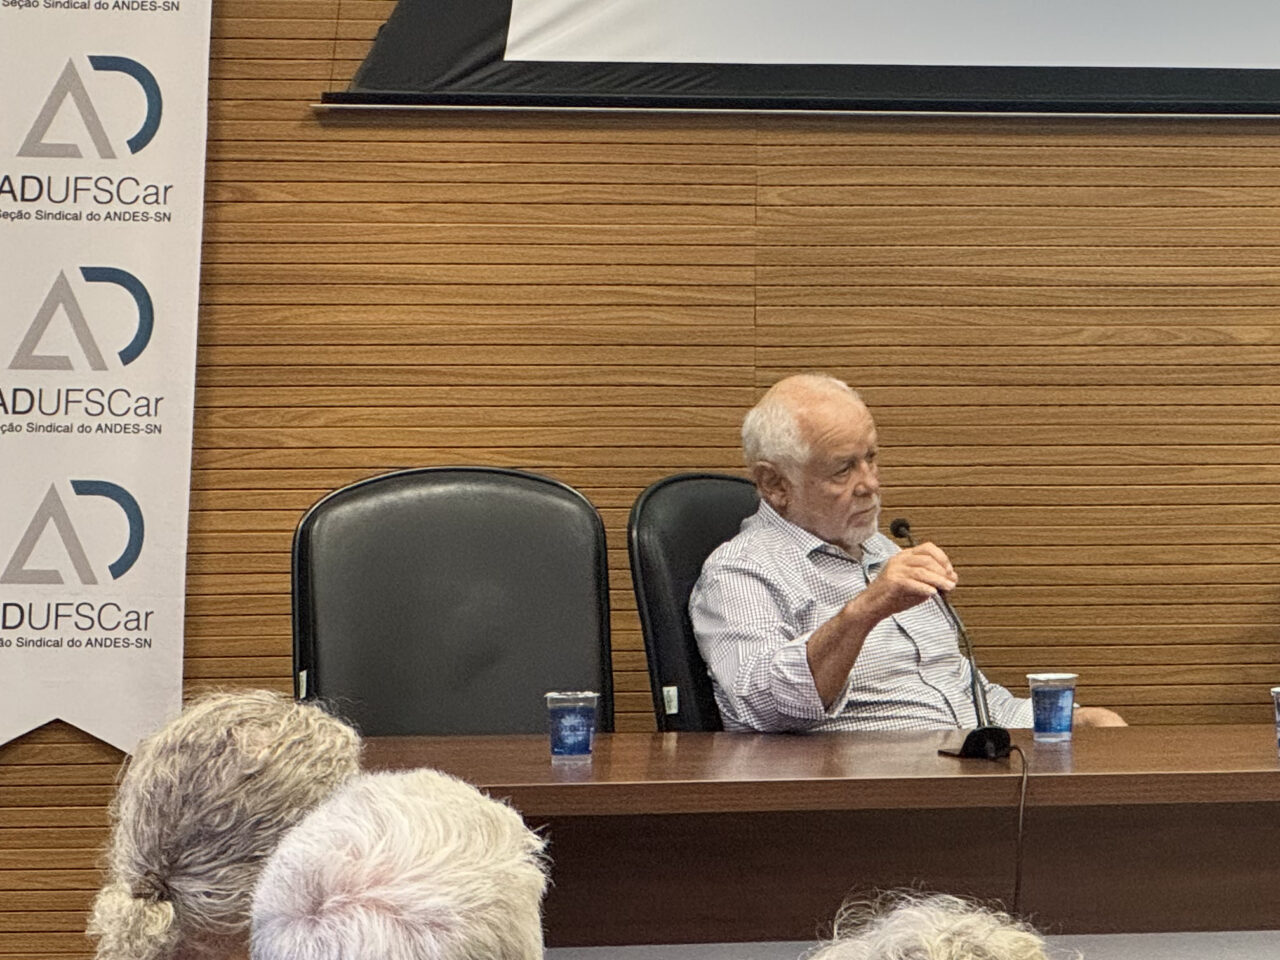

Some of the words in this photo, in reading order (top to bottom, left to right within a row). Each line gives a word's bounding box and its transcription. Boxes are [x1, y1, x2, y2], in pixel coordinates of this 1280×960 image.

[94, 0, 109, 10] do
[112, 0, 179, 11] ANDES-SN
[0, 175, 173, 205] ADUFSCar
[35, 209, 82, 221] Sindical
[86, 211, 102, 222] do
[104, 211, 172, 222] ANDES-SN
